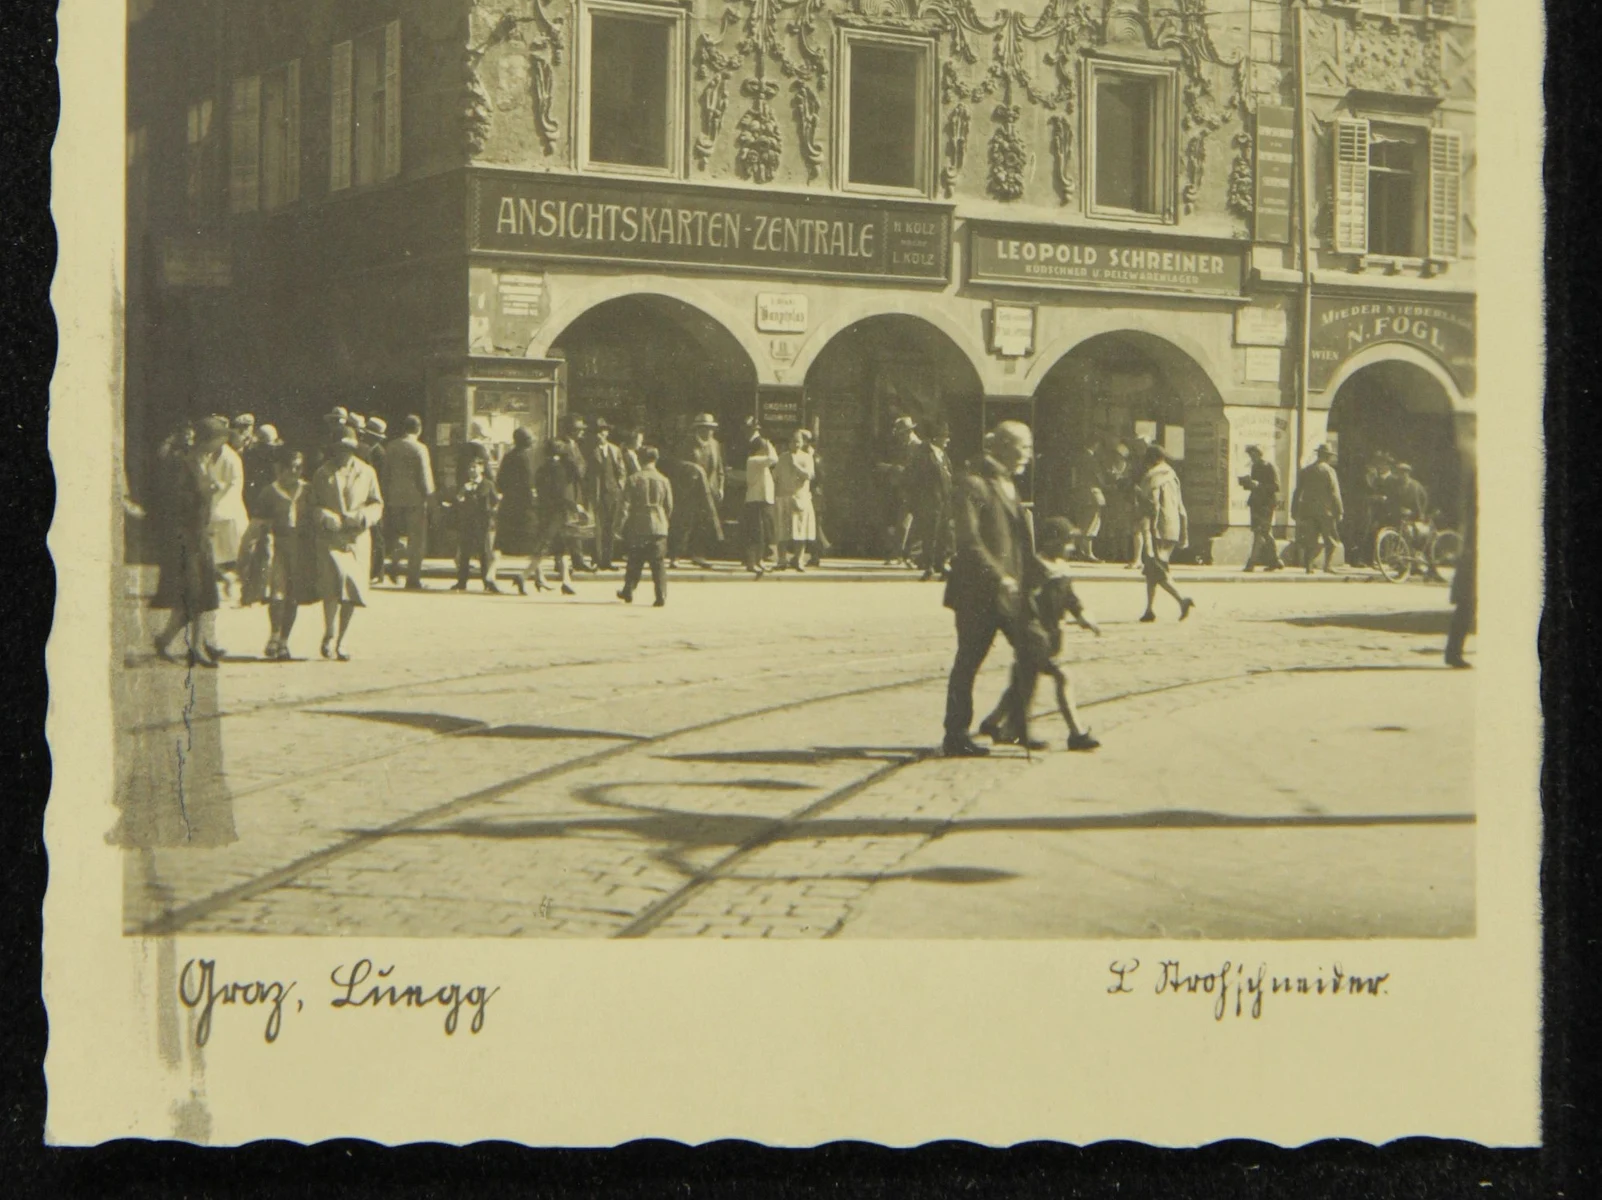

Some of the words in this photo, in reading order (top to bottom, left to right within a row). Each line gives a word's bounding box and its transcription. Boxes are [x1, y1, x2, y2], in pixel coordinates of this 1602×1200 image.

[997, 239, 1097, 265] LEOPOLD
[1109, 248, 1224, 274] SCHREINER
[1320, 304, 1381, 327] MIEDER
[1311, 350, 1340, 361] WIEN
